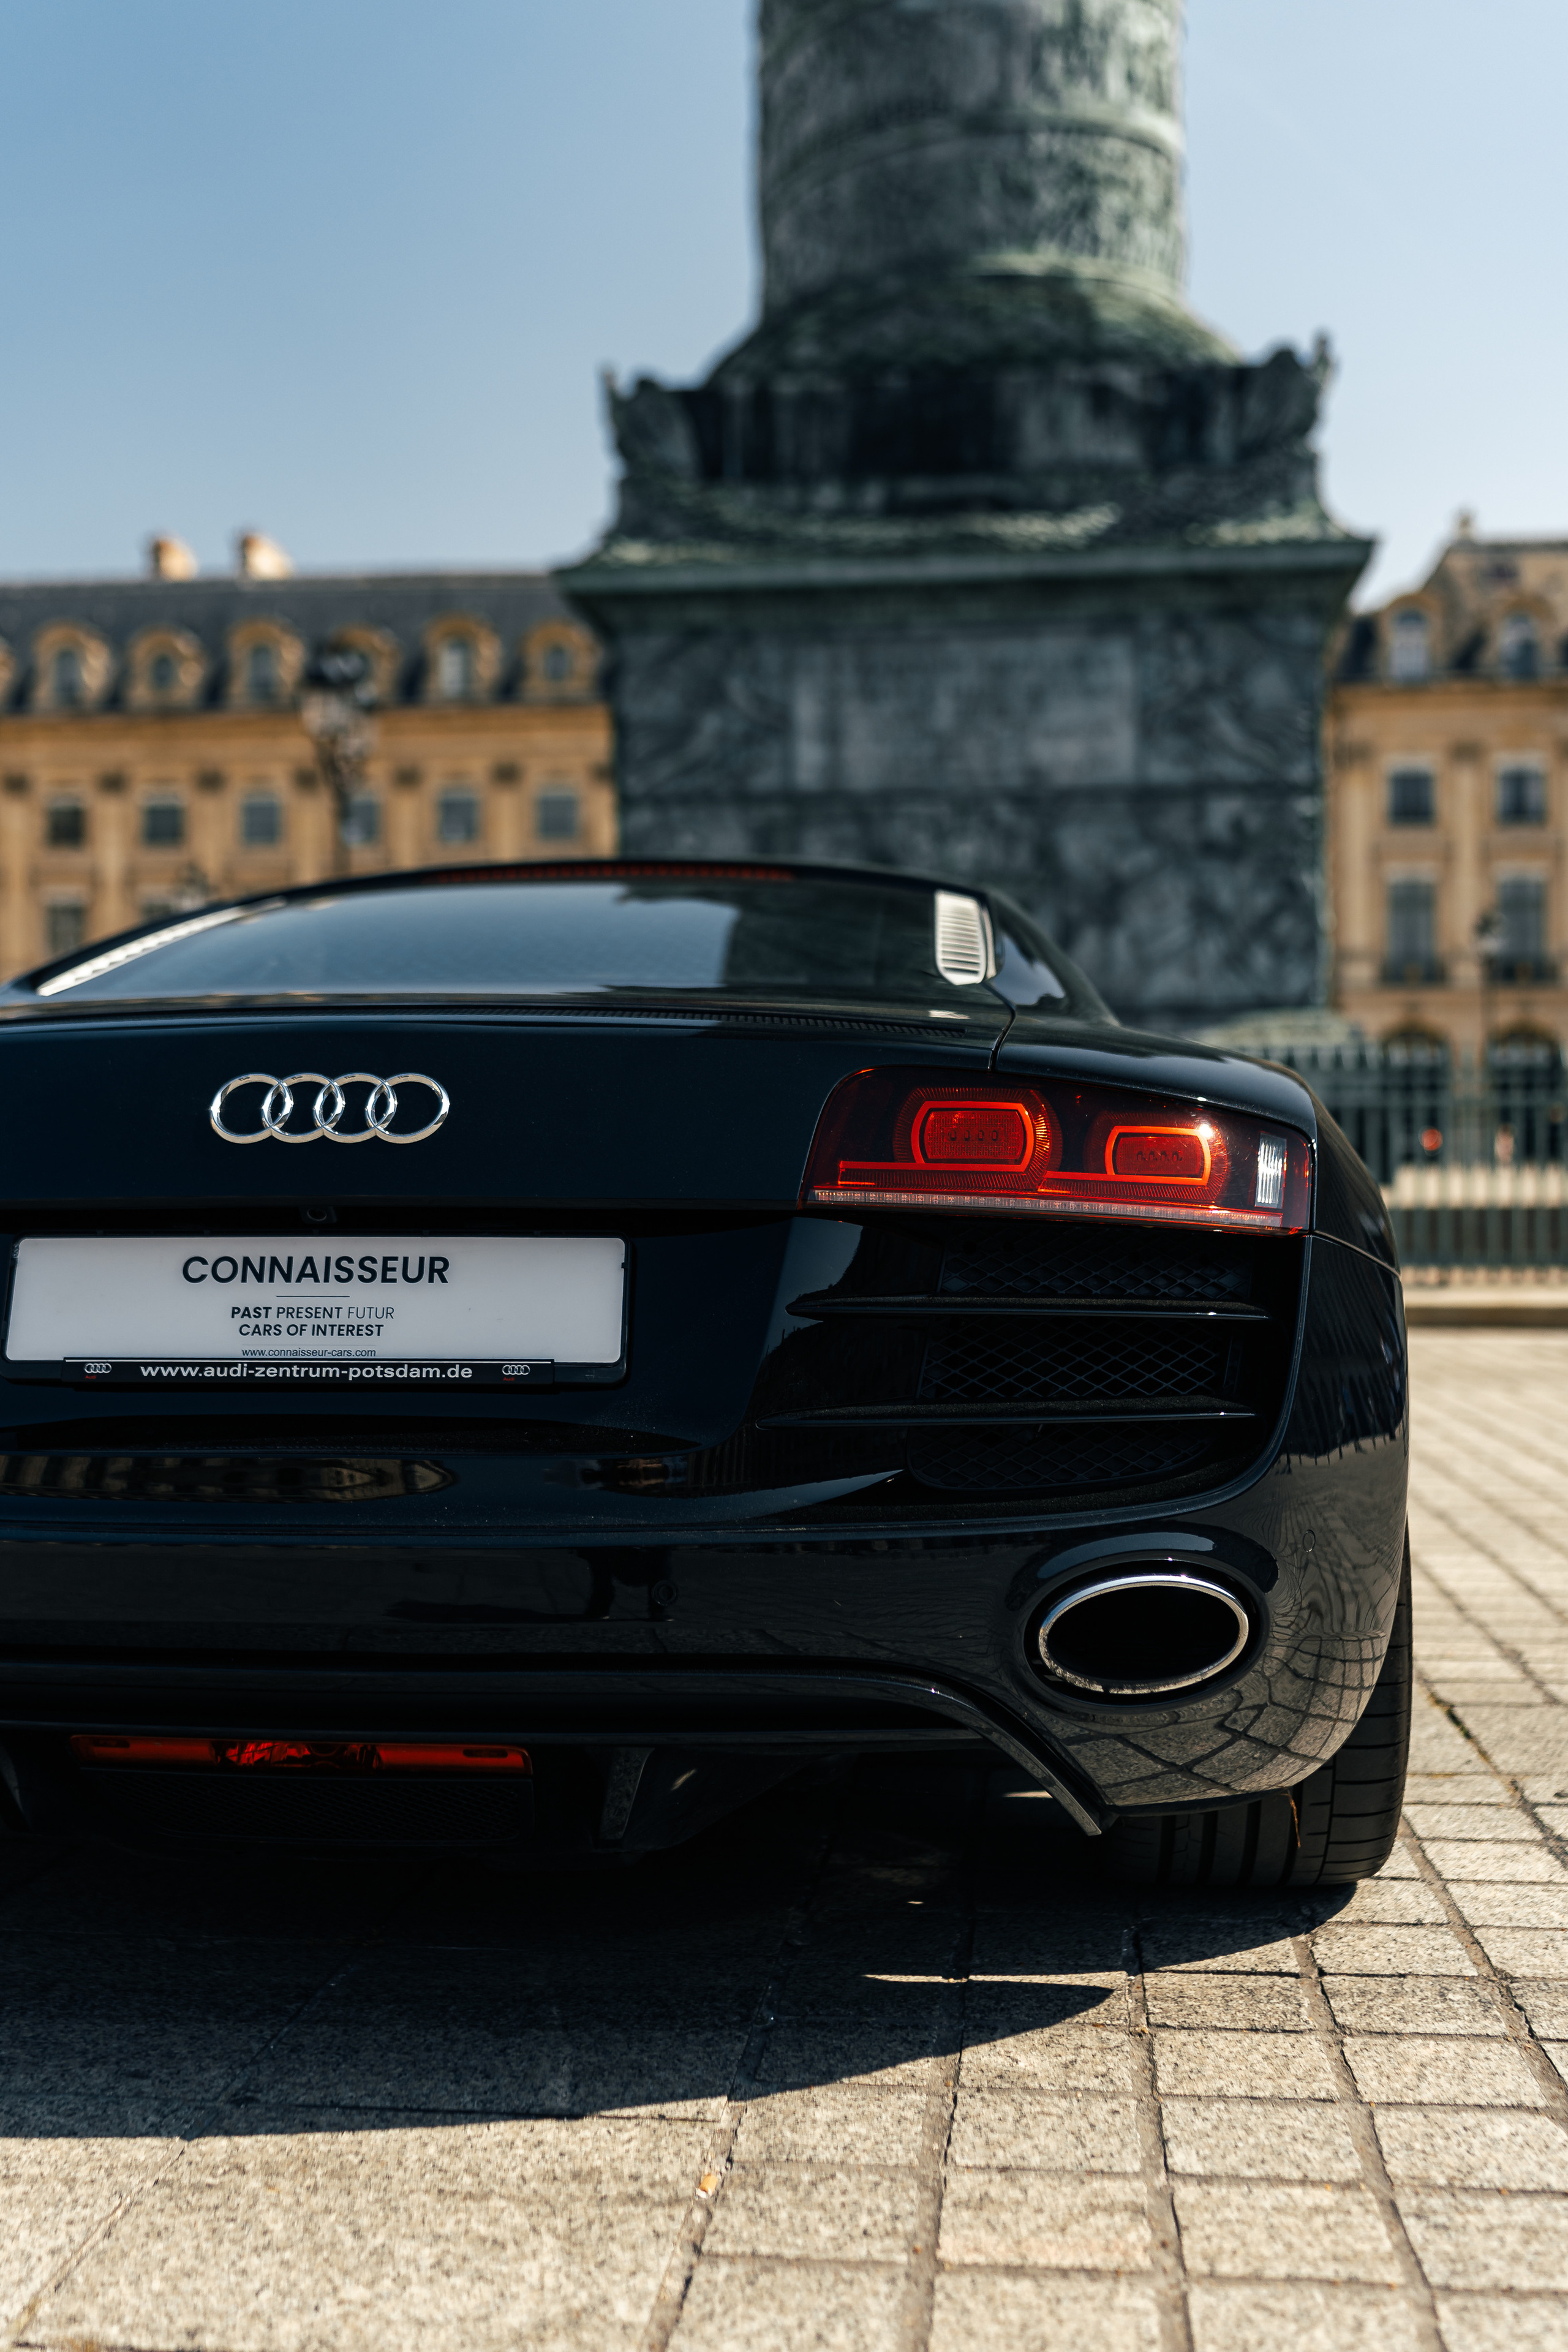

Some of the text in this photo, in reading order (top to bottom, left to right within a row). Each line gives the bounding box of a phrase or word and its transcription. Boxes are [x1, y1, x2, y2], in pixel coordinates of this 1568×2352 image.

[183, 1256, 450, 1284] CONNAISSEUR
[231, 1306, 394, 1319] PAST PRESENT FUTUR
[239, 1324, 384, 1336] CARS OF INTEREST
[242, 1348, 376, 1357] www.connaisseur-cars.com
[140, 1363, 473, 1381] www.audi-zentrum-potsdam.de
